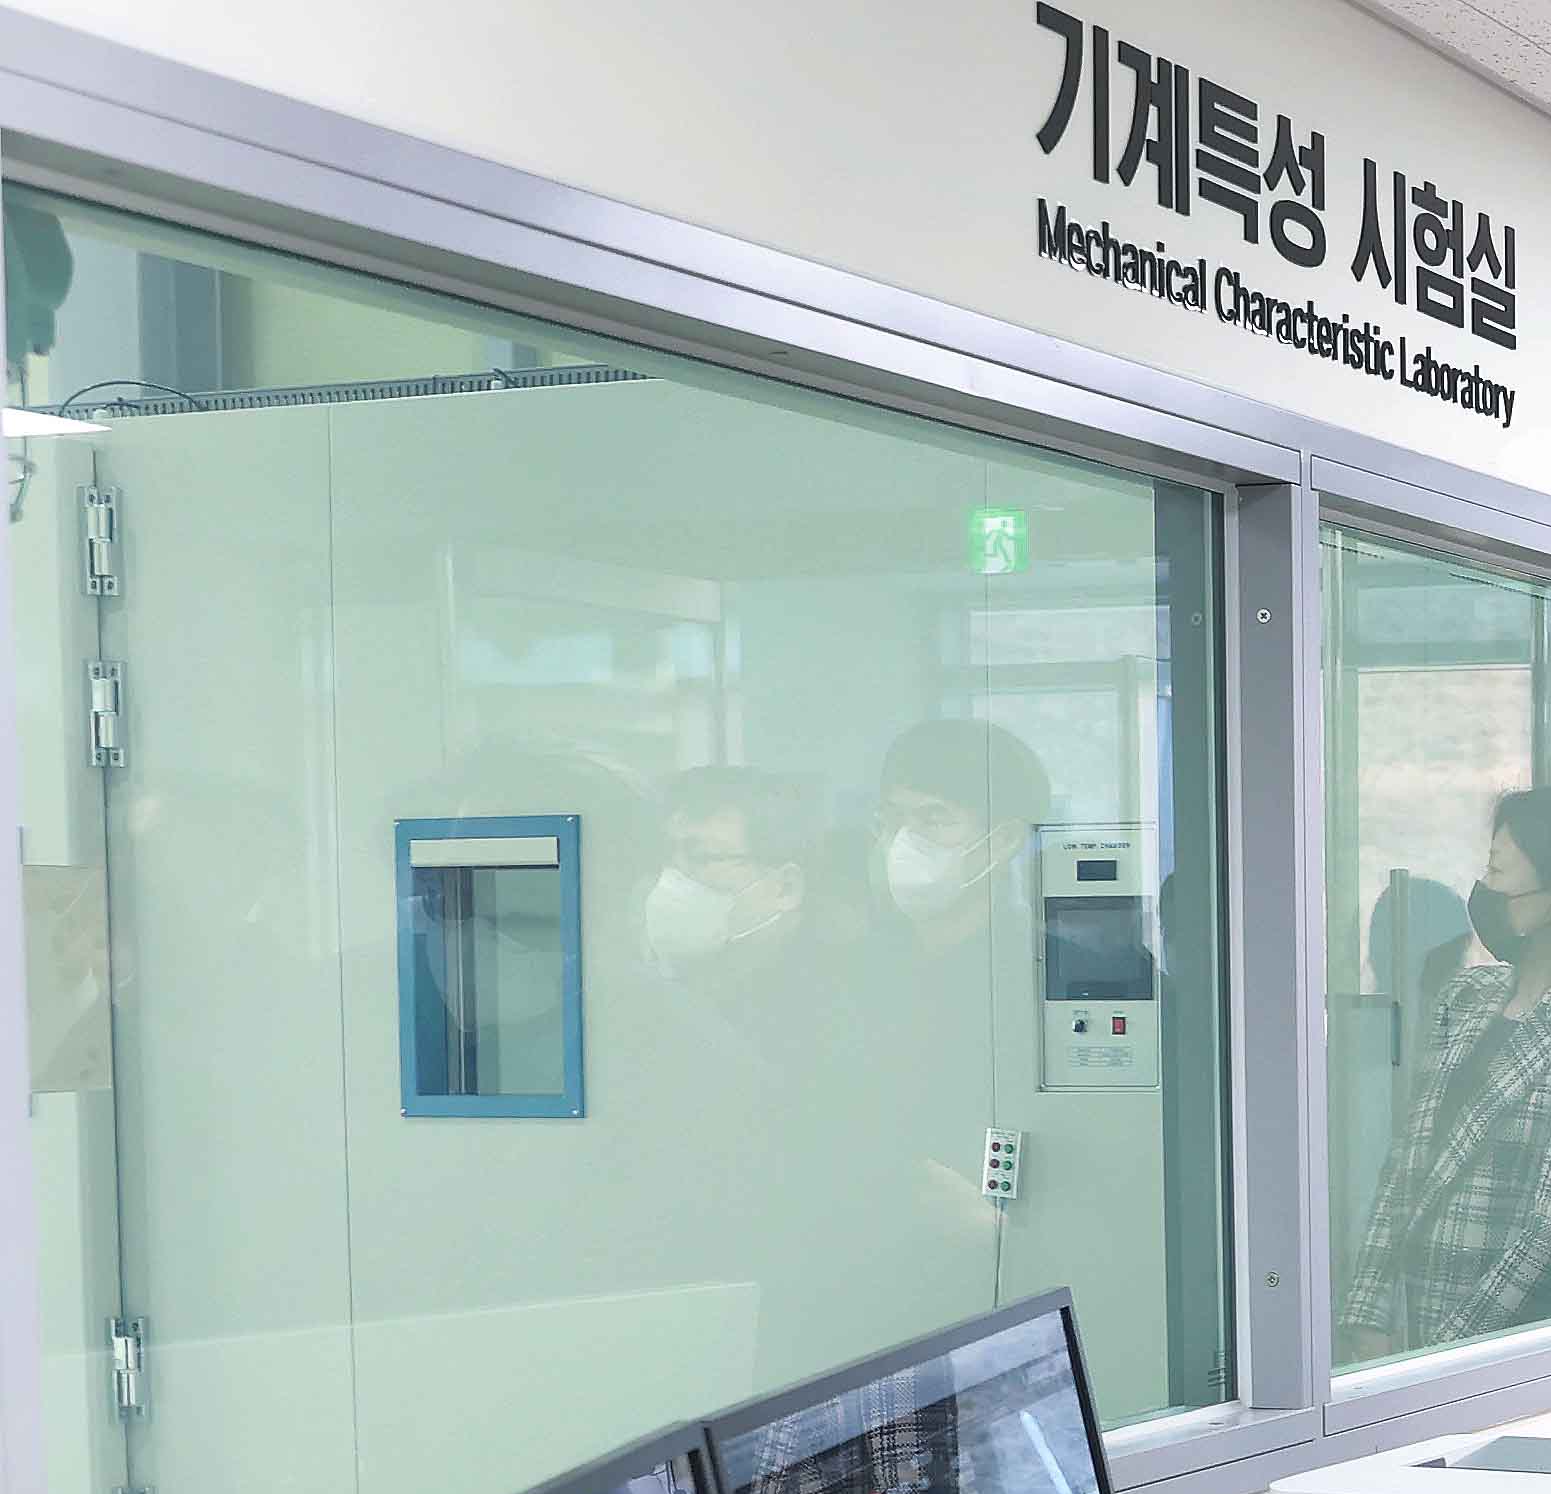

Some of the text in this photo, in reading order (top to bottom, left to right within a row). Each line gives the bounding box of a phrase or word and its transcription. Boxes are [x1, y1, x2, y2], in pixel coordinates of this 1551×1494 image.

[1037, 1, 1516, 350] 기계특성 시험실
[1038, 198, 1516, 429] Mechanical Characteristic Laboratory
